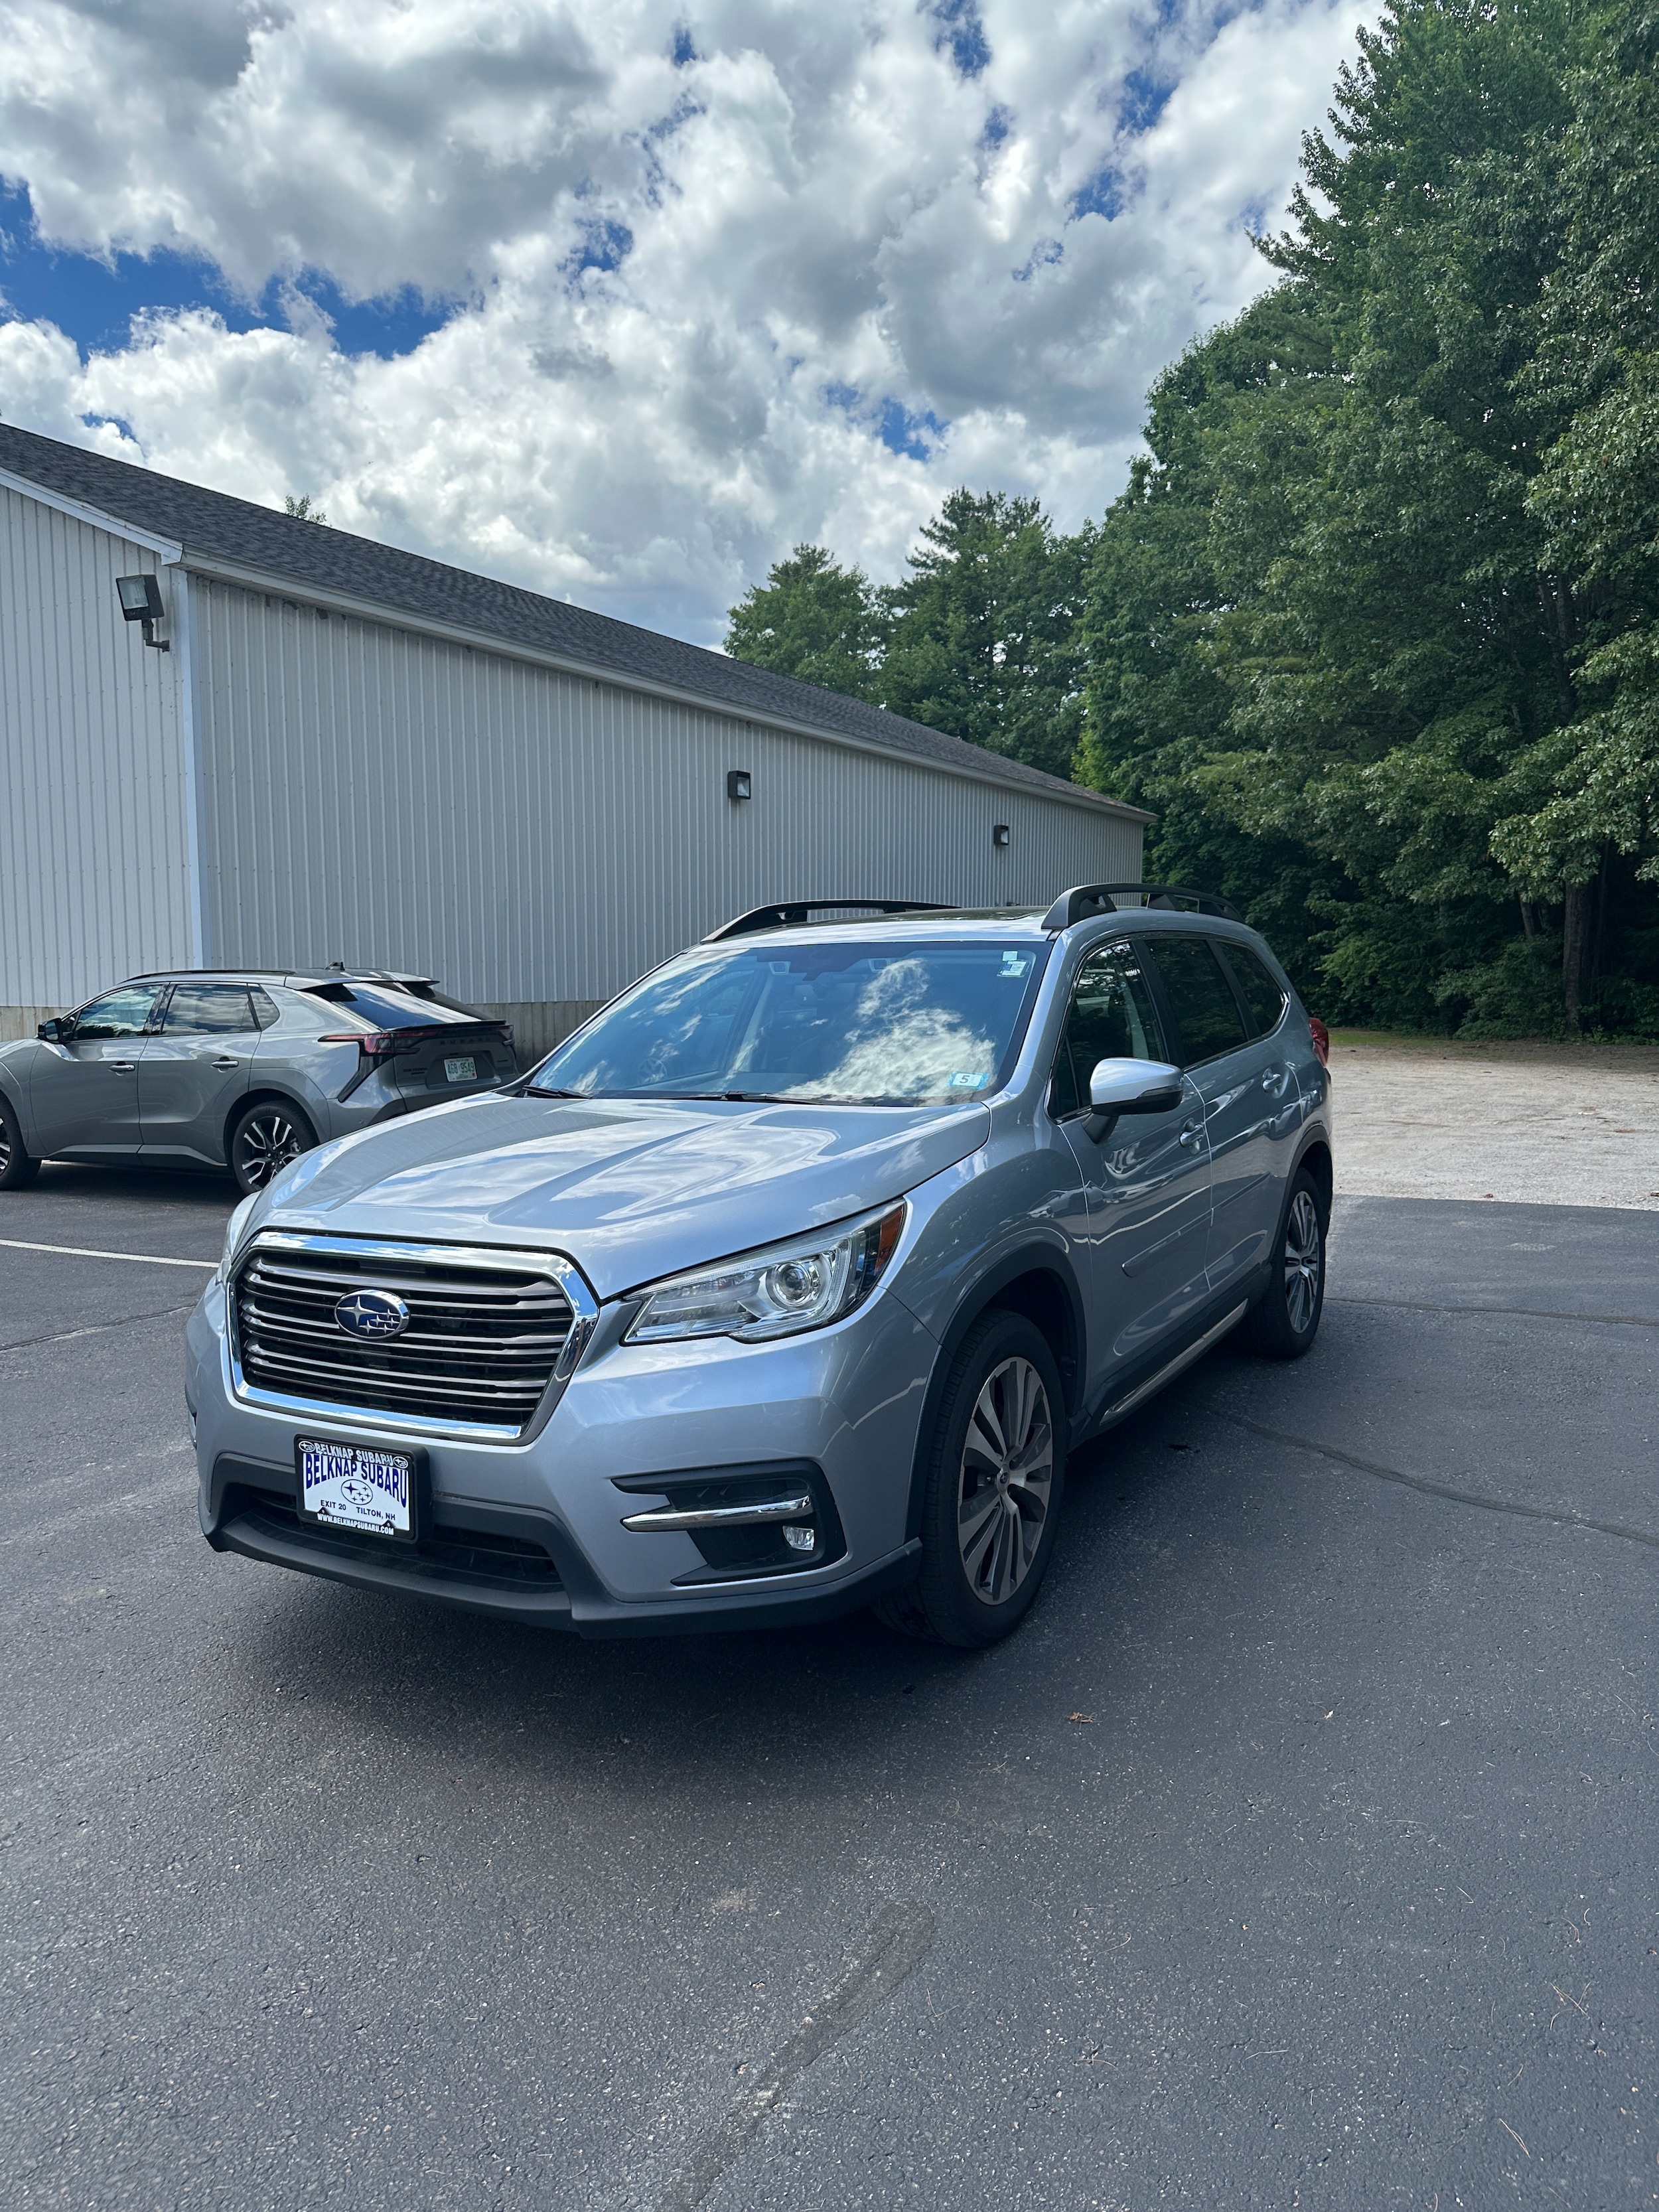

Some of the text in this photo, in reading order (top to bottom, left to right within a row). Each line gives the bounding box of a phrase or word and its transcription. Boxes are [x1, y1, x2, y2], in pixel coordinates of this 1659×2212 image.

[448, 1062, 474, 1074] 468 9549
[314, 1443, 394, 1466] BELKNAP SUBARU
[306, 1453, 407, 1508] BELKNAP SUBARU
[321, 1500, 336, 1509] EXIT
[356, 1507, 384, 1519] TILTON,
[317, 1513, 394, 1535] WWW.BELKNAPSUBARU.COM
